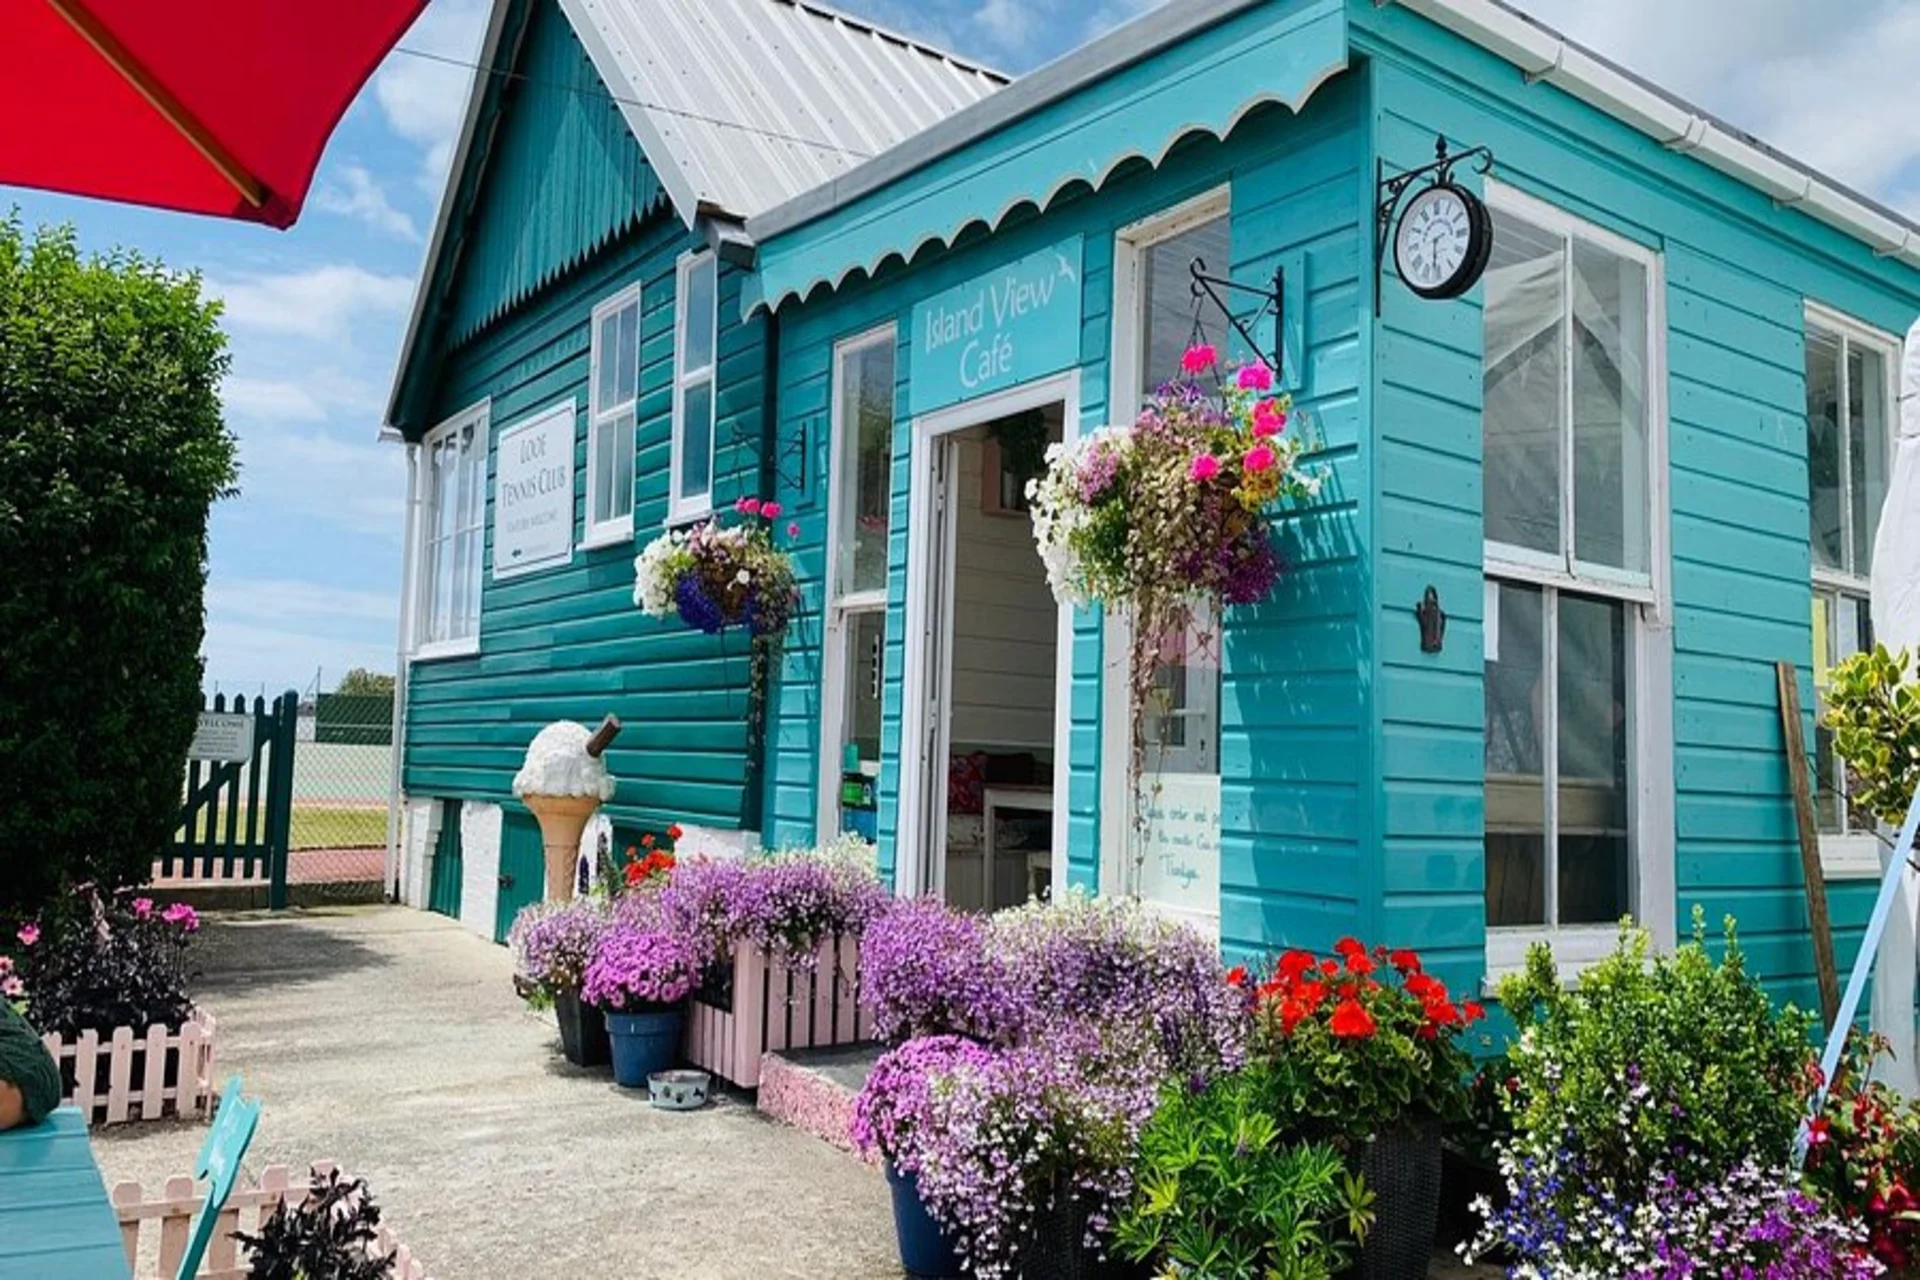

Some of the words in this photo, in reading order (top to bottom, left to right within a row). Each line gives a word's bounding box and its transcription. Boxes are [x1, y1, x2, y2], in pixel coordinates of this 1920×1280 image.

[925, 288, 984, 354] Island
[990, 273, 1055, 328] View
[960, 332, 1013, 388] Café
[502, 473, 536, 508] TENNIS
[539, 466, 566, 495] CLUB
